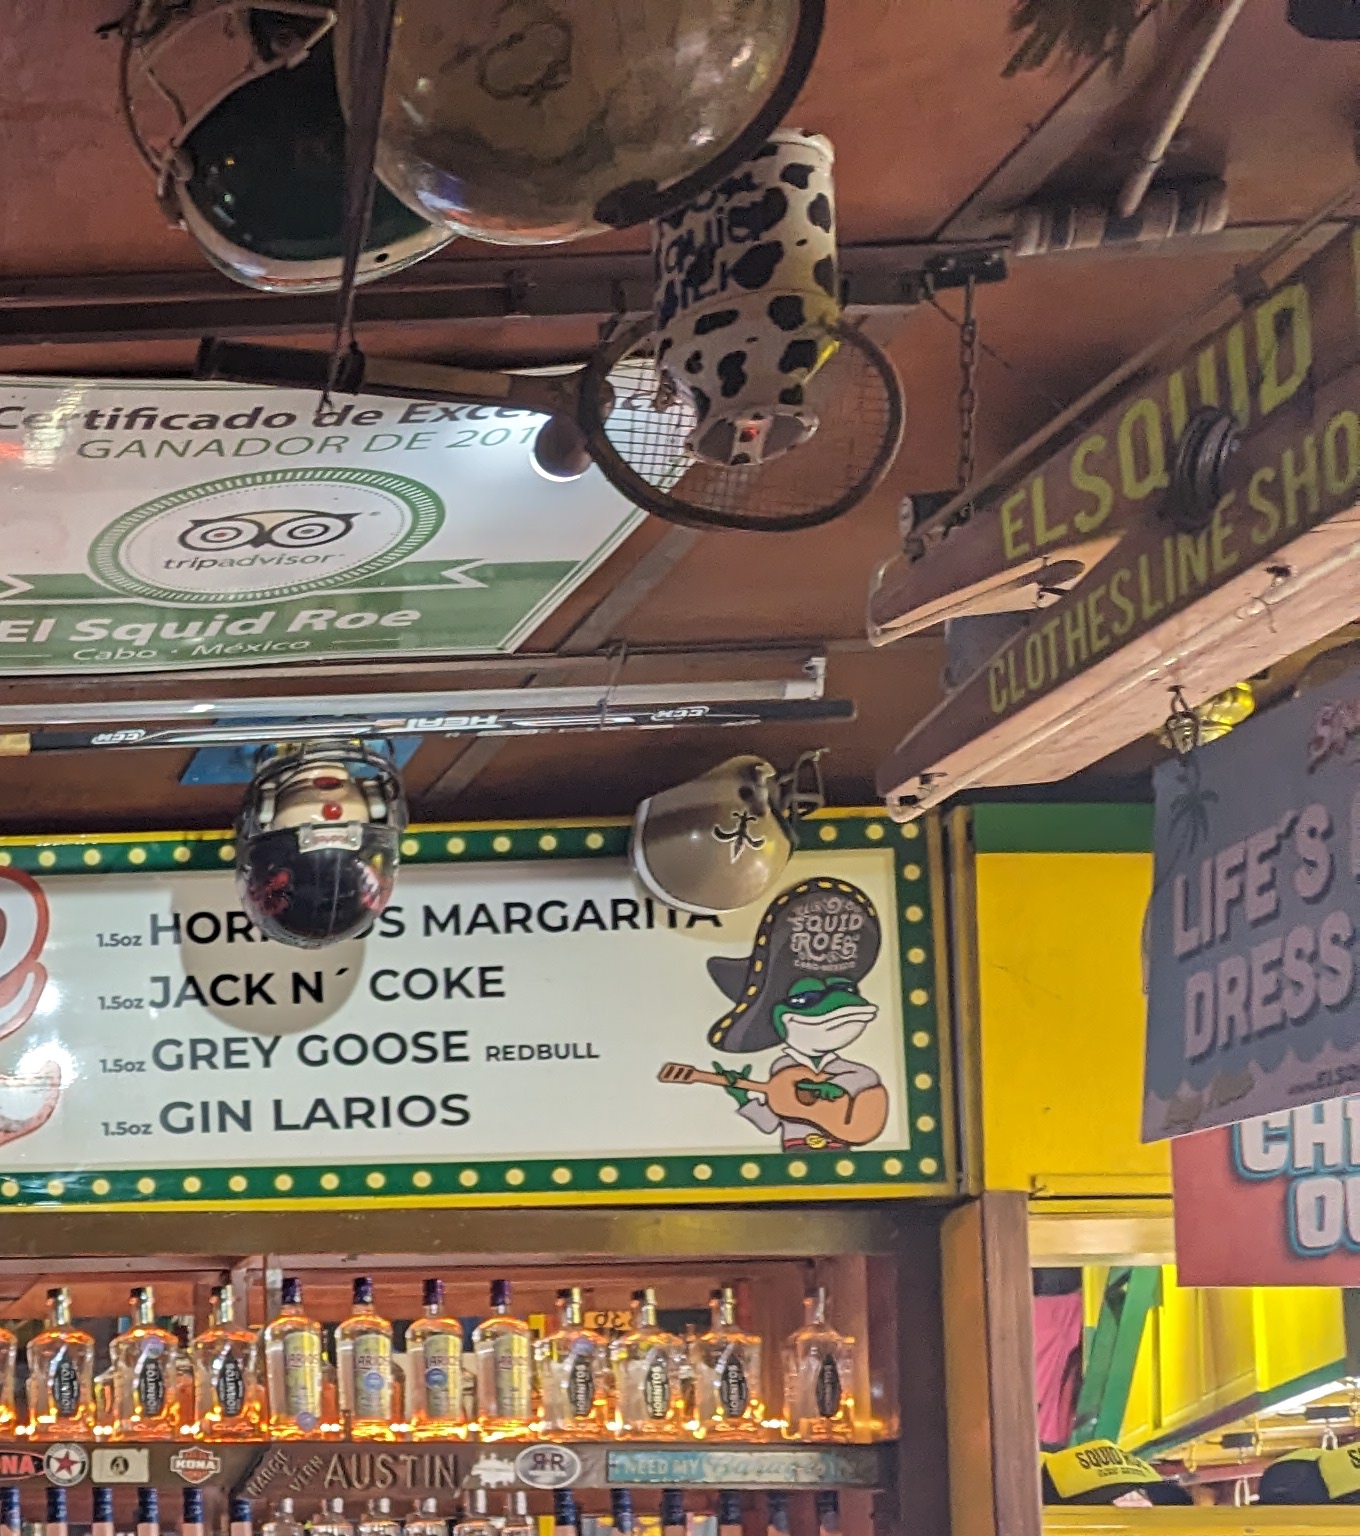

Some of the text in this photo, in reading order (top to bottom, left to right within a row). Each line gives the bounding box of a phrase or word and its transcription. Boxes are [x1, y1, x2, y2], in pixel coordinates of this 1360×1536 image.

[311, 401, 385, 428] de
[77, 431, 432, 460] GANADOR DE
[999, 476, 1067, 560] EL
[162, 548, 338, 574] tripadvisor
[70, 610, 280, 648] Squid
[285, 605, 422, 633] Roe
[72, 637, 311, 662] Cabo México
[1172, 801, 1335, 962] LIFE'S
[95, 931, 144, 949] 1.5oz
[791, 912, 865, 934] SQUID
[98, 994, 145, 1012] 1.5oz
[147, 971, 279, 1010] JACK
[367, 964, 507, 1003] COKE
[1183, 910, 1358, 1066] DRESS
[99, 1029, 601, 1075] 1.5oz GREY GOOSE REDBULL
[100, 1093, 472, 1138] 1.5oz GIN LARIOS
[175, 1458, 220, 1471] KONA
[323, 1452, 459, 1491] AUSTIN
[1075, 1446, 1122, 1470] SQUID
